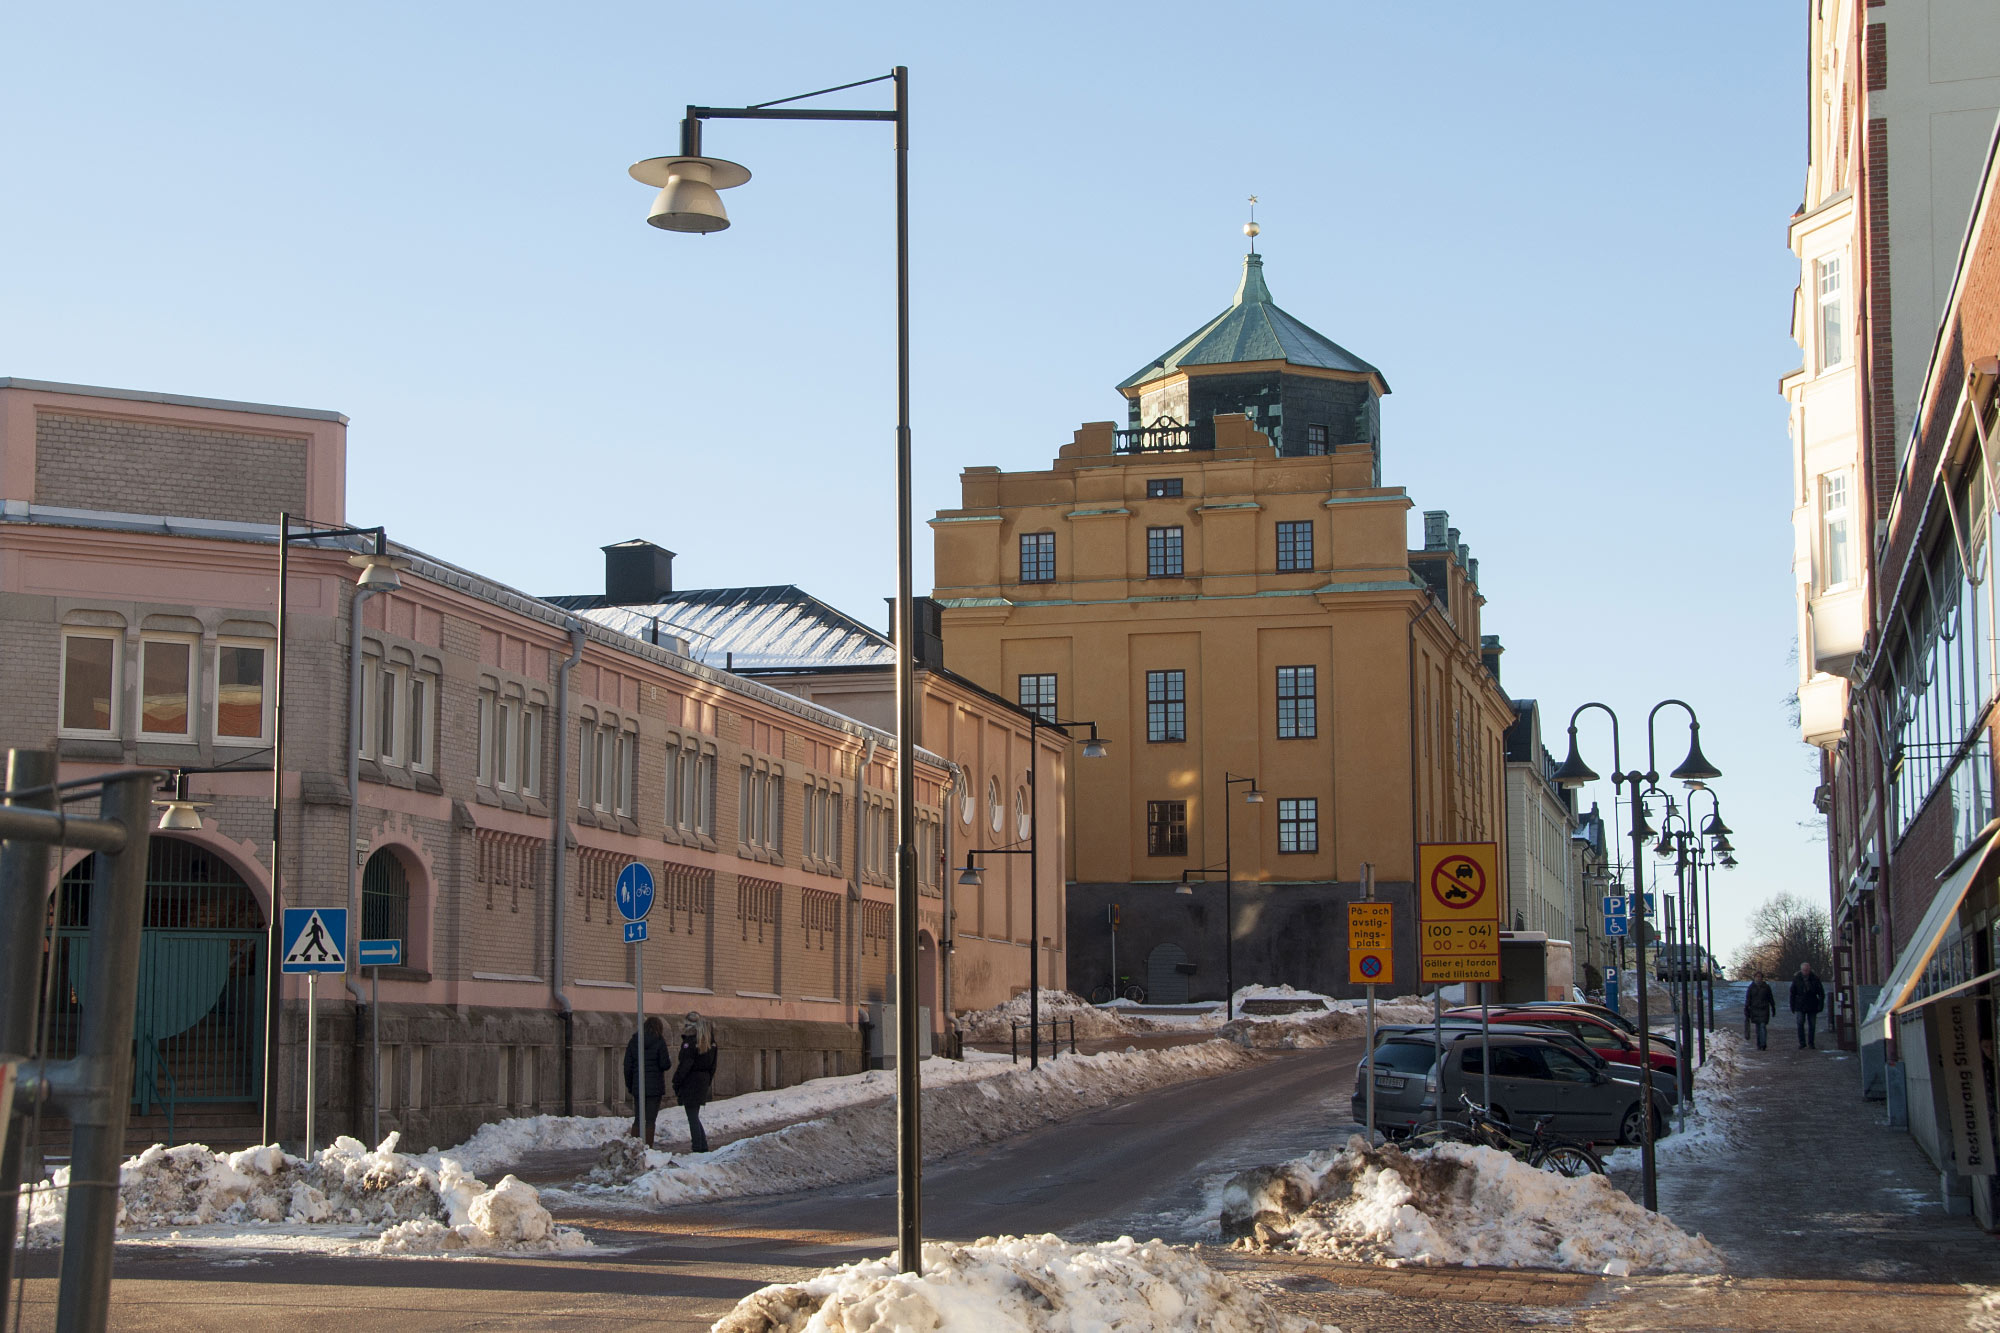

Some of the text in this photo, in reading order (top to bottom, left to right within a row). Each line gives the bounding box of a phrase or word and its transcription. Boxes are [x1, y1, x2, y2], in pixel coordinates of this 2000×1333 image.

[1351, 906, 1389, 915] På- och
[1610, 898, 1621, 914] P
[1352, 918, 1388, 928] avstig-
[1354, 930, 1386, 939] nings-
[1428, 925, 1452, 937] (00
[1468, 924, 1492, 936] 04)
[1356, 939, 1380, 948] plats
[1433, 940, 1452, 951] 00
[1468, 939, 1487, 950] 04
[1424, 959, 1452, 967] Gäller
[1455, 960, 1464, 968] ej
[1431, 970, 1490, 979] med tillstånd
[1951, 1005, 1982, 1166] Restaurang Slussen
